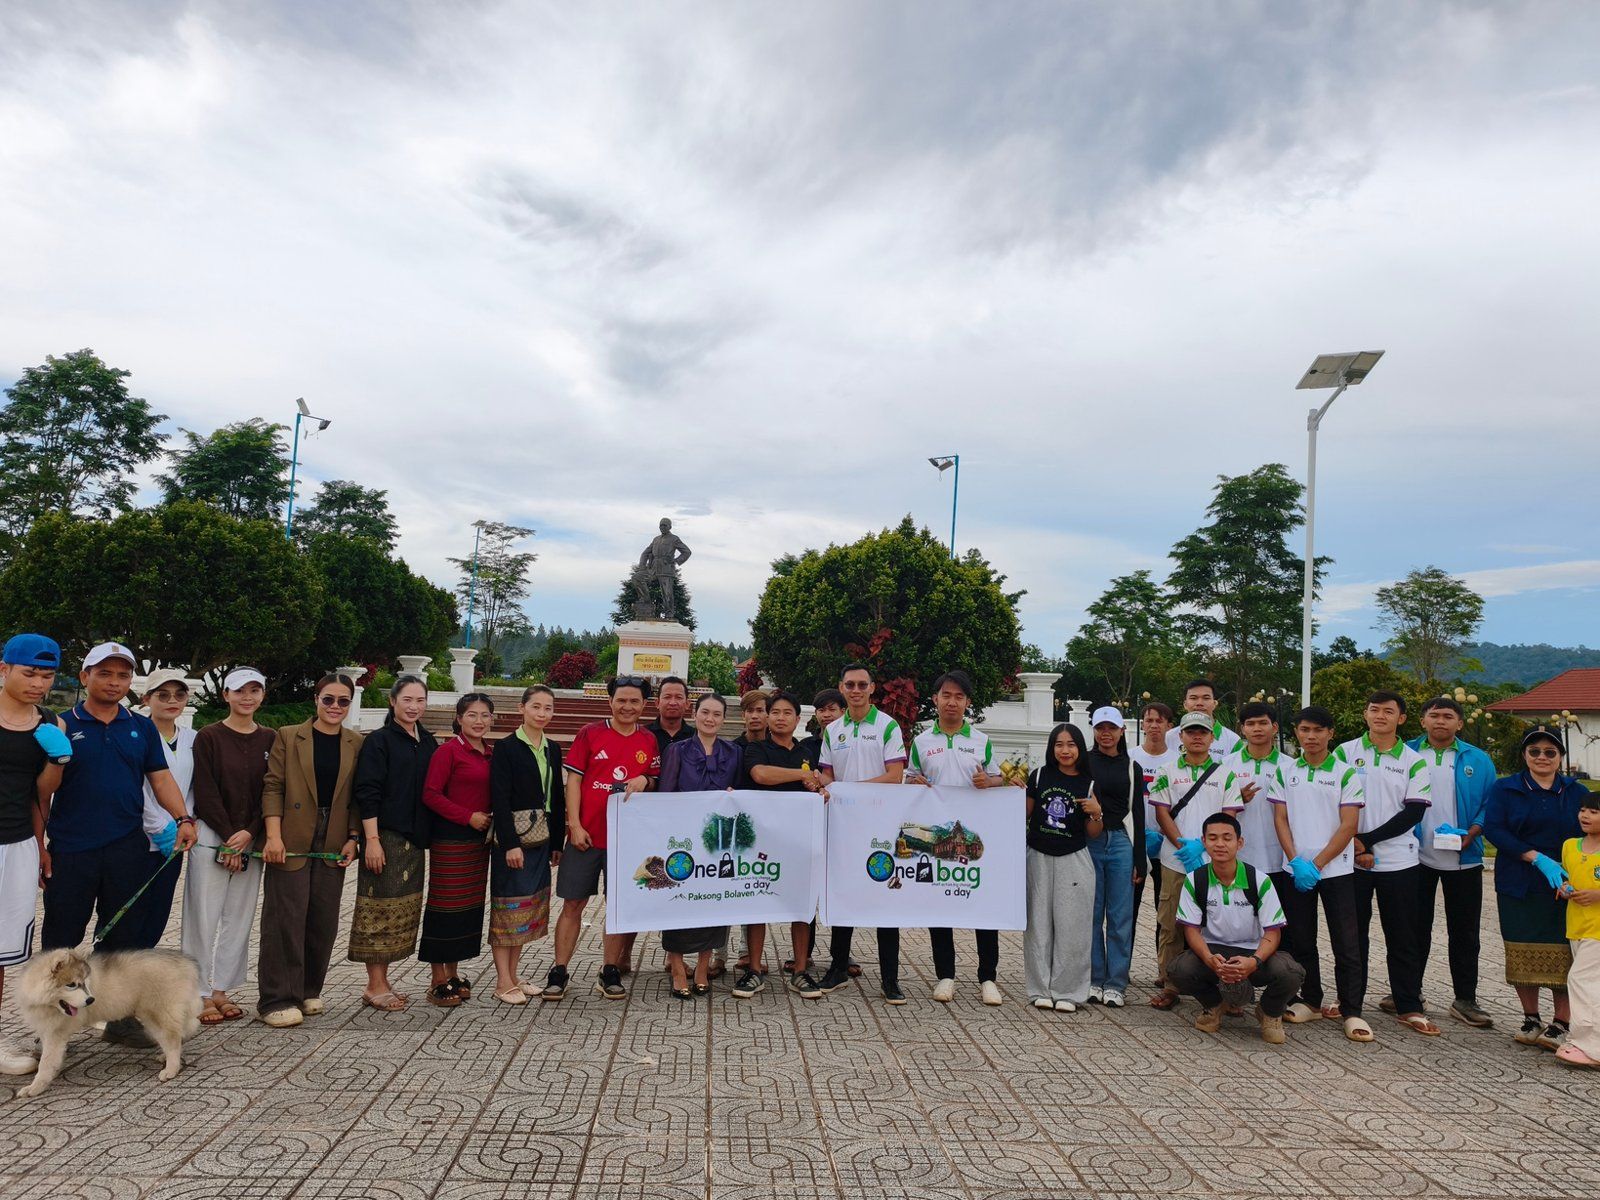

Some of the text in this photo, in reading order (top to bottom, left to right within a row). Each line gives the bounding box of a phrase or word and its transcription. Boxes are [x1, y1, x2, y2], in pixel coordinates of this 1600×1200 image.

[738, 855, 780, 881] bag
[937, 859, 980, 889] bag
[753, 880, 770, 890] day
[688, 890, 755, 901] Paksong Bolaven
[953, 887, 971, 899] day
